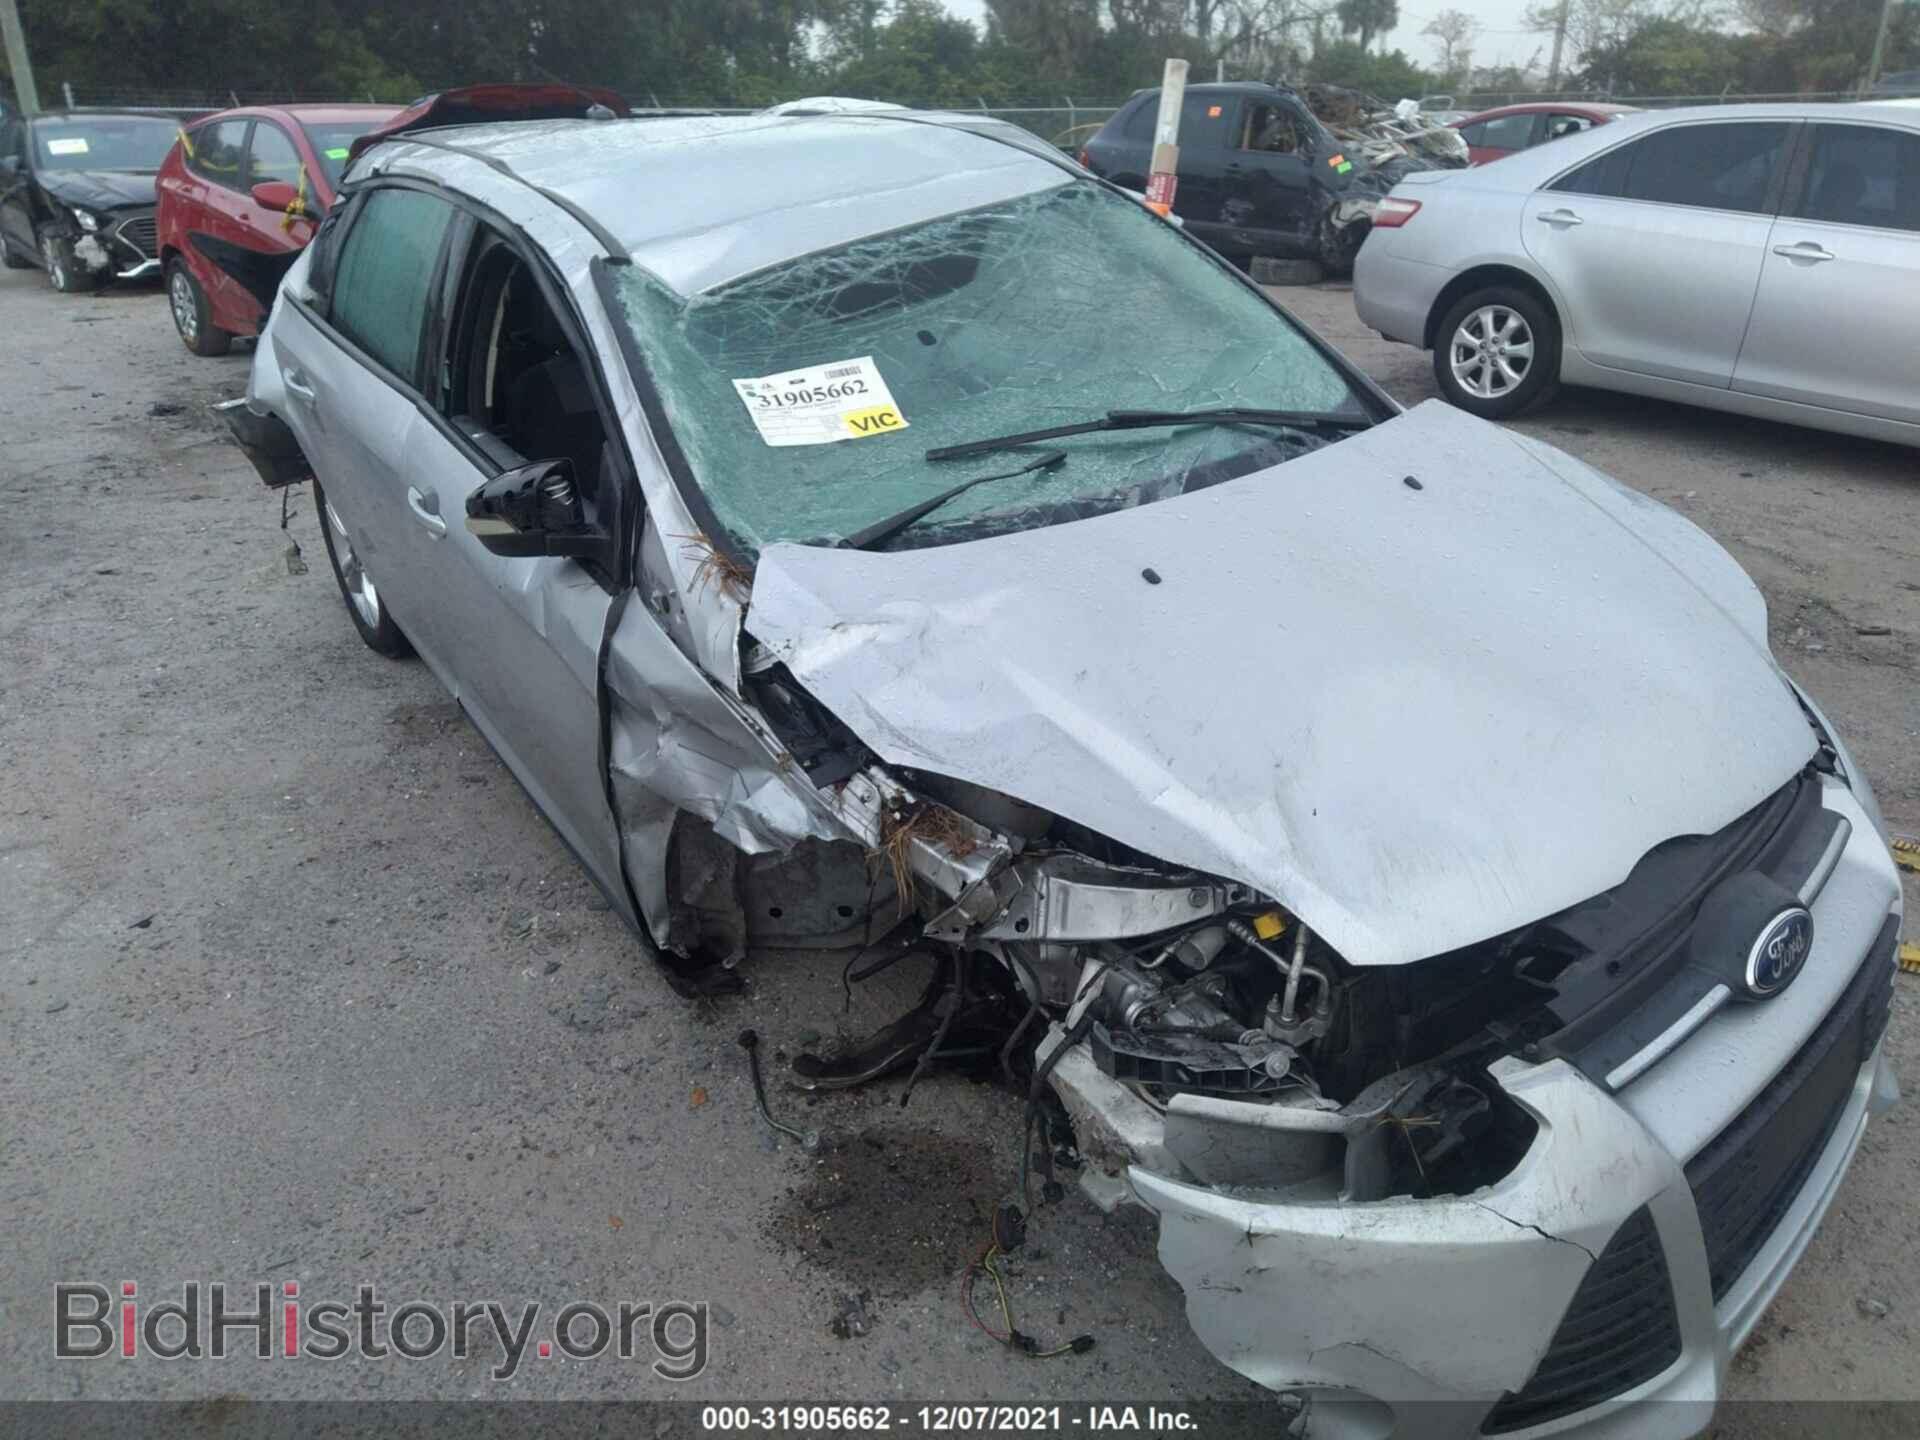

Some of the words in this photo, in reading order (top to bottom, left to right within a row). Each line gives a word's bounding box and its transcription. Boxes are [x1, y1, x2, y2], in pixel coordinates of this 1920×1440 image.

[756, 379, 869, 408] 31905662
[850, 412, 898, 432] VIC
[1767, 922, 1804, 979] Ford
